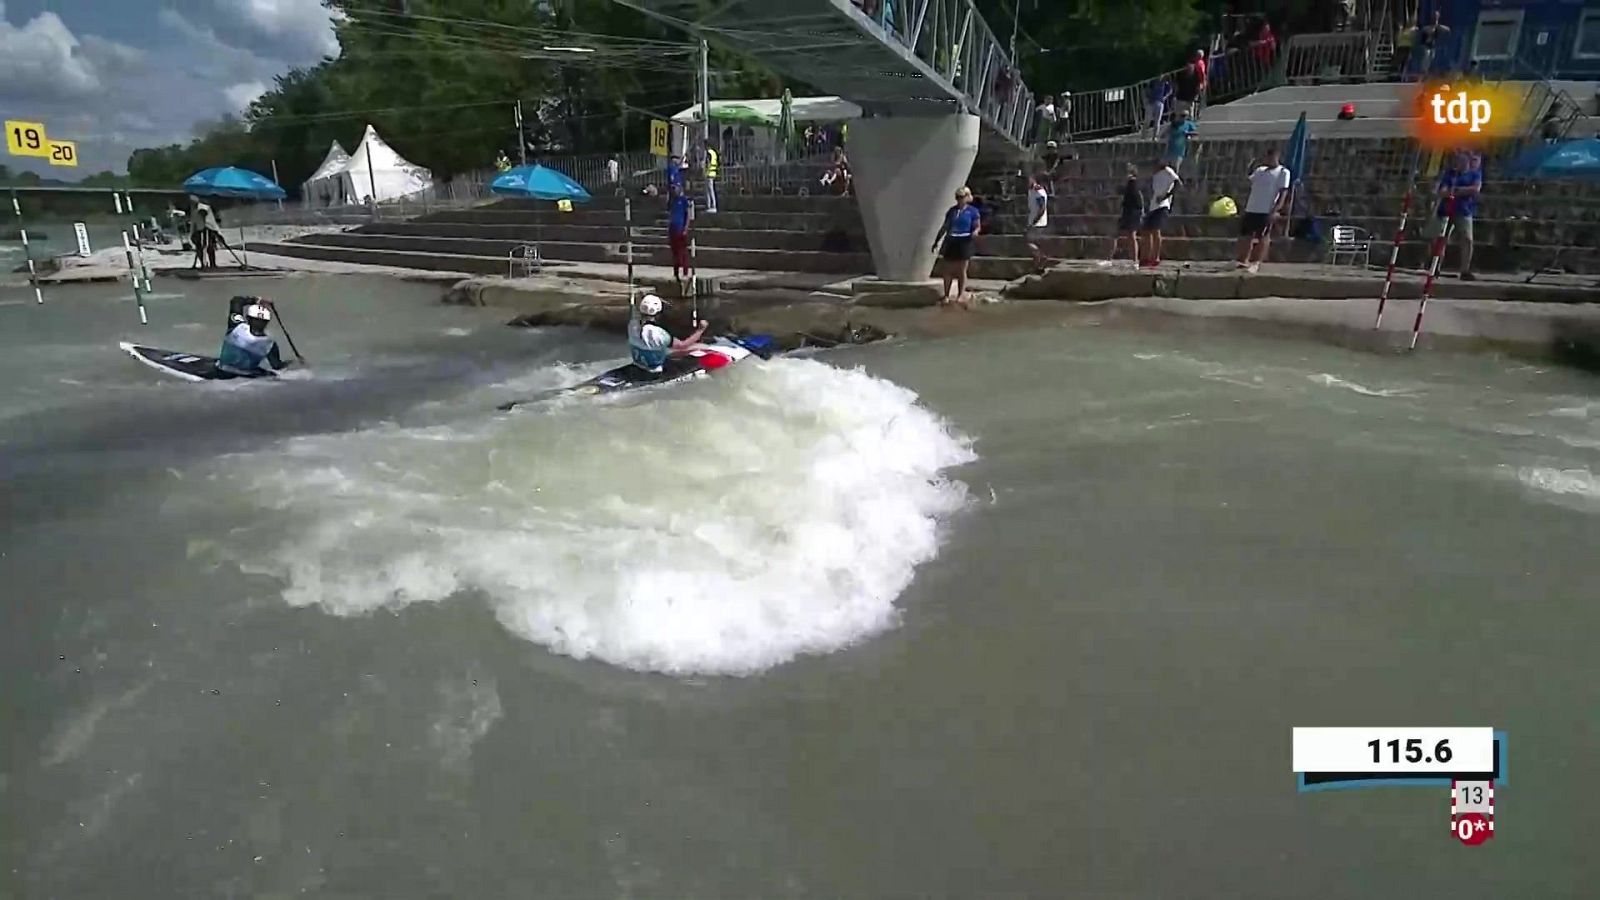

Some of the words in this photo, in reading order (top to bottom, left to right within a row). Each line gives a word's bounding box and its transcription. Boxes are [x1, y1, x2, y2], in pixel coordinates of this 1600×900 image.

[14, 127, 40, 149] 19
[655, 127, 665, 147] 18
[52, 145, 73, 161] 20
